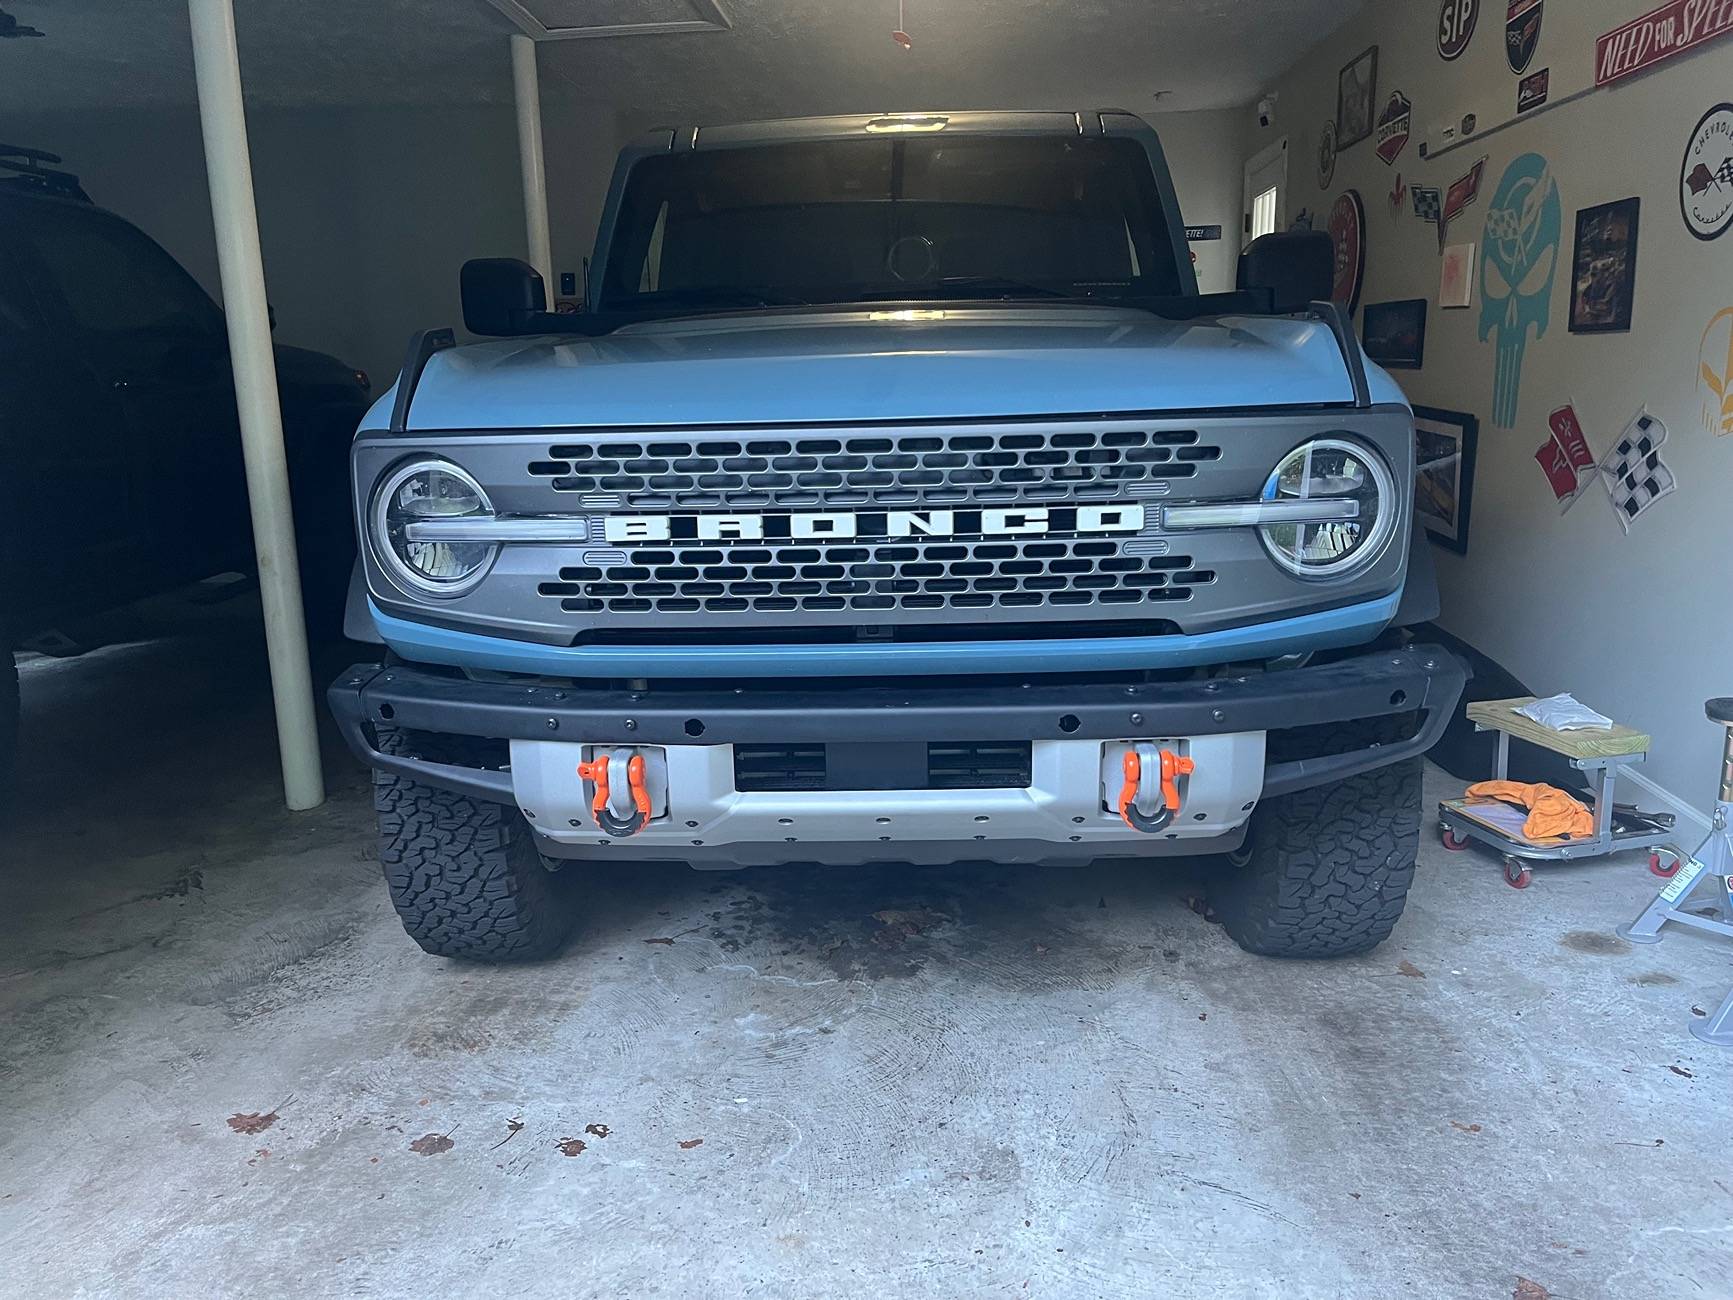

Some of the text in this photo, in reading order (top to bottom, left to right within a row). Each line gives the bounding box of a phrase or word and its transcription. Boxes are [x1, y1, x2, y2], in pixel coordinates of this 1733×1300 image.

[1599, 21, 1654, 80] NEED
[1654, 16, 1676, 52] FOR
[1378, 117, 1408, 144] CORVETTE
[1695, 121, 1733, 155] CHEVROLE
[1185, 229, 1204, 238] ETTE!
[604, 504, 1144, 542] BRONCO
